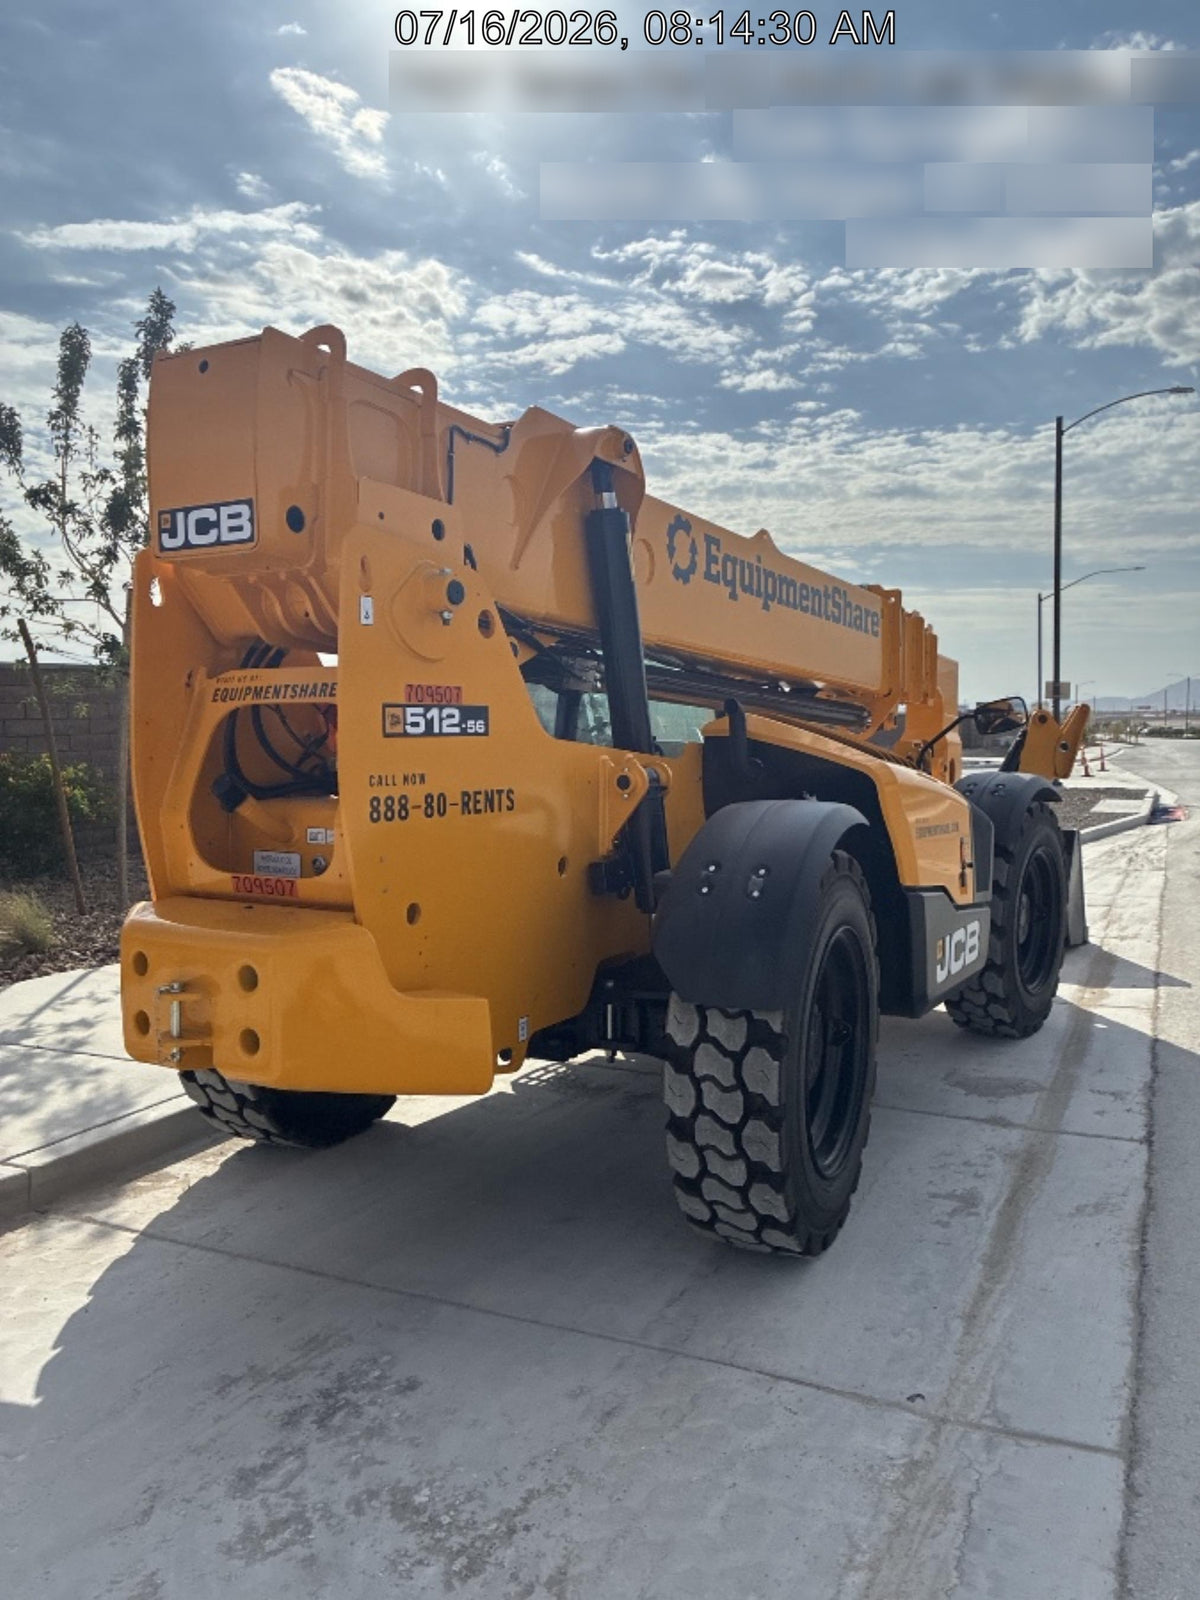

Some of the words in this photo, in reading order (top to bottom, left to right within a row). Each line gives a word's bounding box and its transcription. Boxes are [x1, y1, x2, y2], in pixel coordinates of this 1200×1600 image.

[160, 504, 252, 549] JCB
[703, 533, 880, 638] EquipmentShare
[211, 682, 338, 702] EQUIPMENTSHARE
[405, 684, 462, 703] 709507
[369, 774, 397, 787] CALL
[403, 773, 426, 786] NOW
[369, 788, 515, 823] 888-80-RENTS
[231, 875, 297, 897] 709507
[936, 920, 980, 983] JCB
